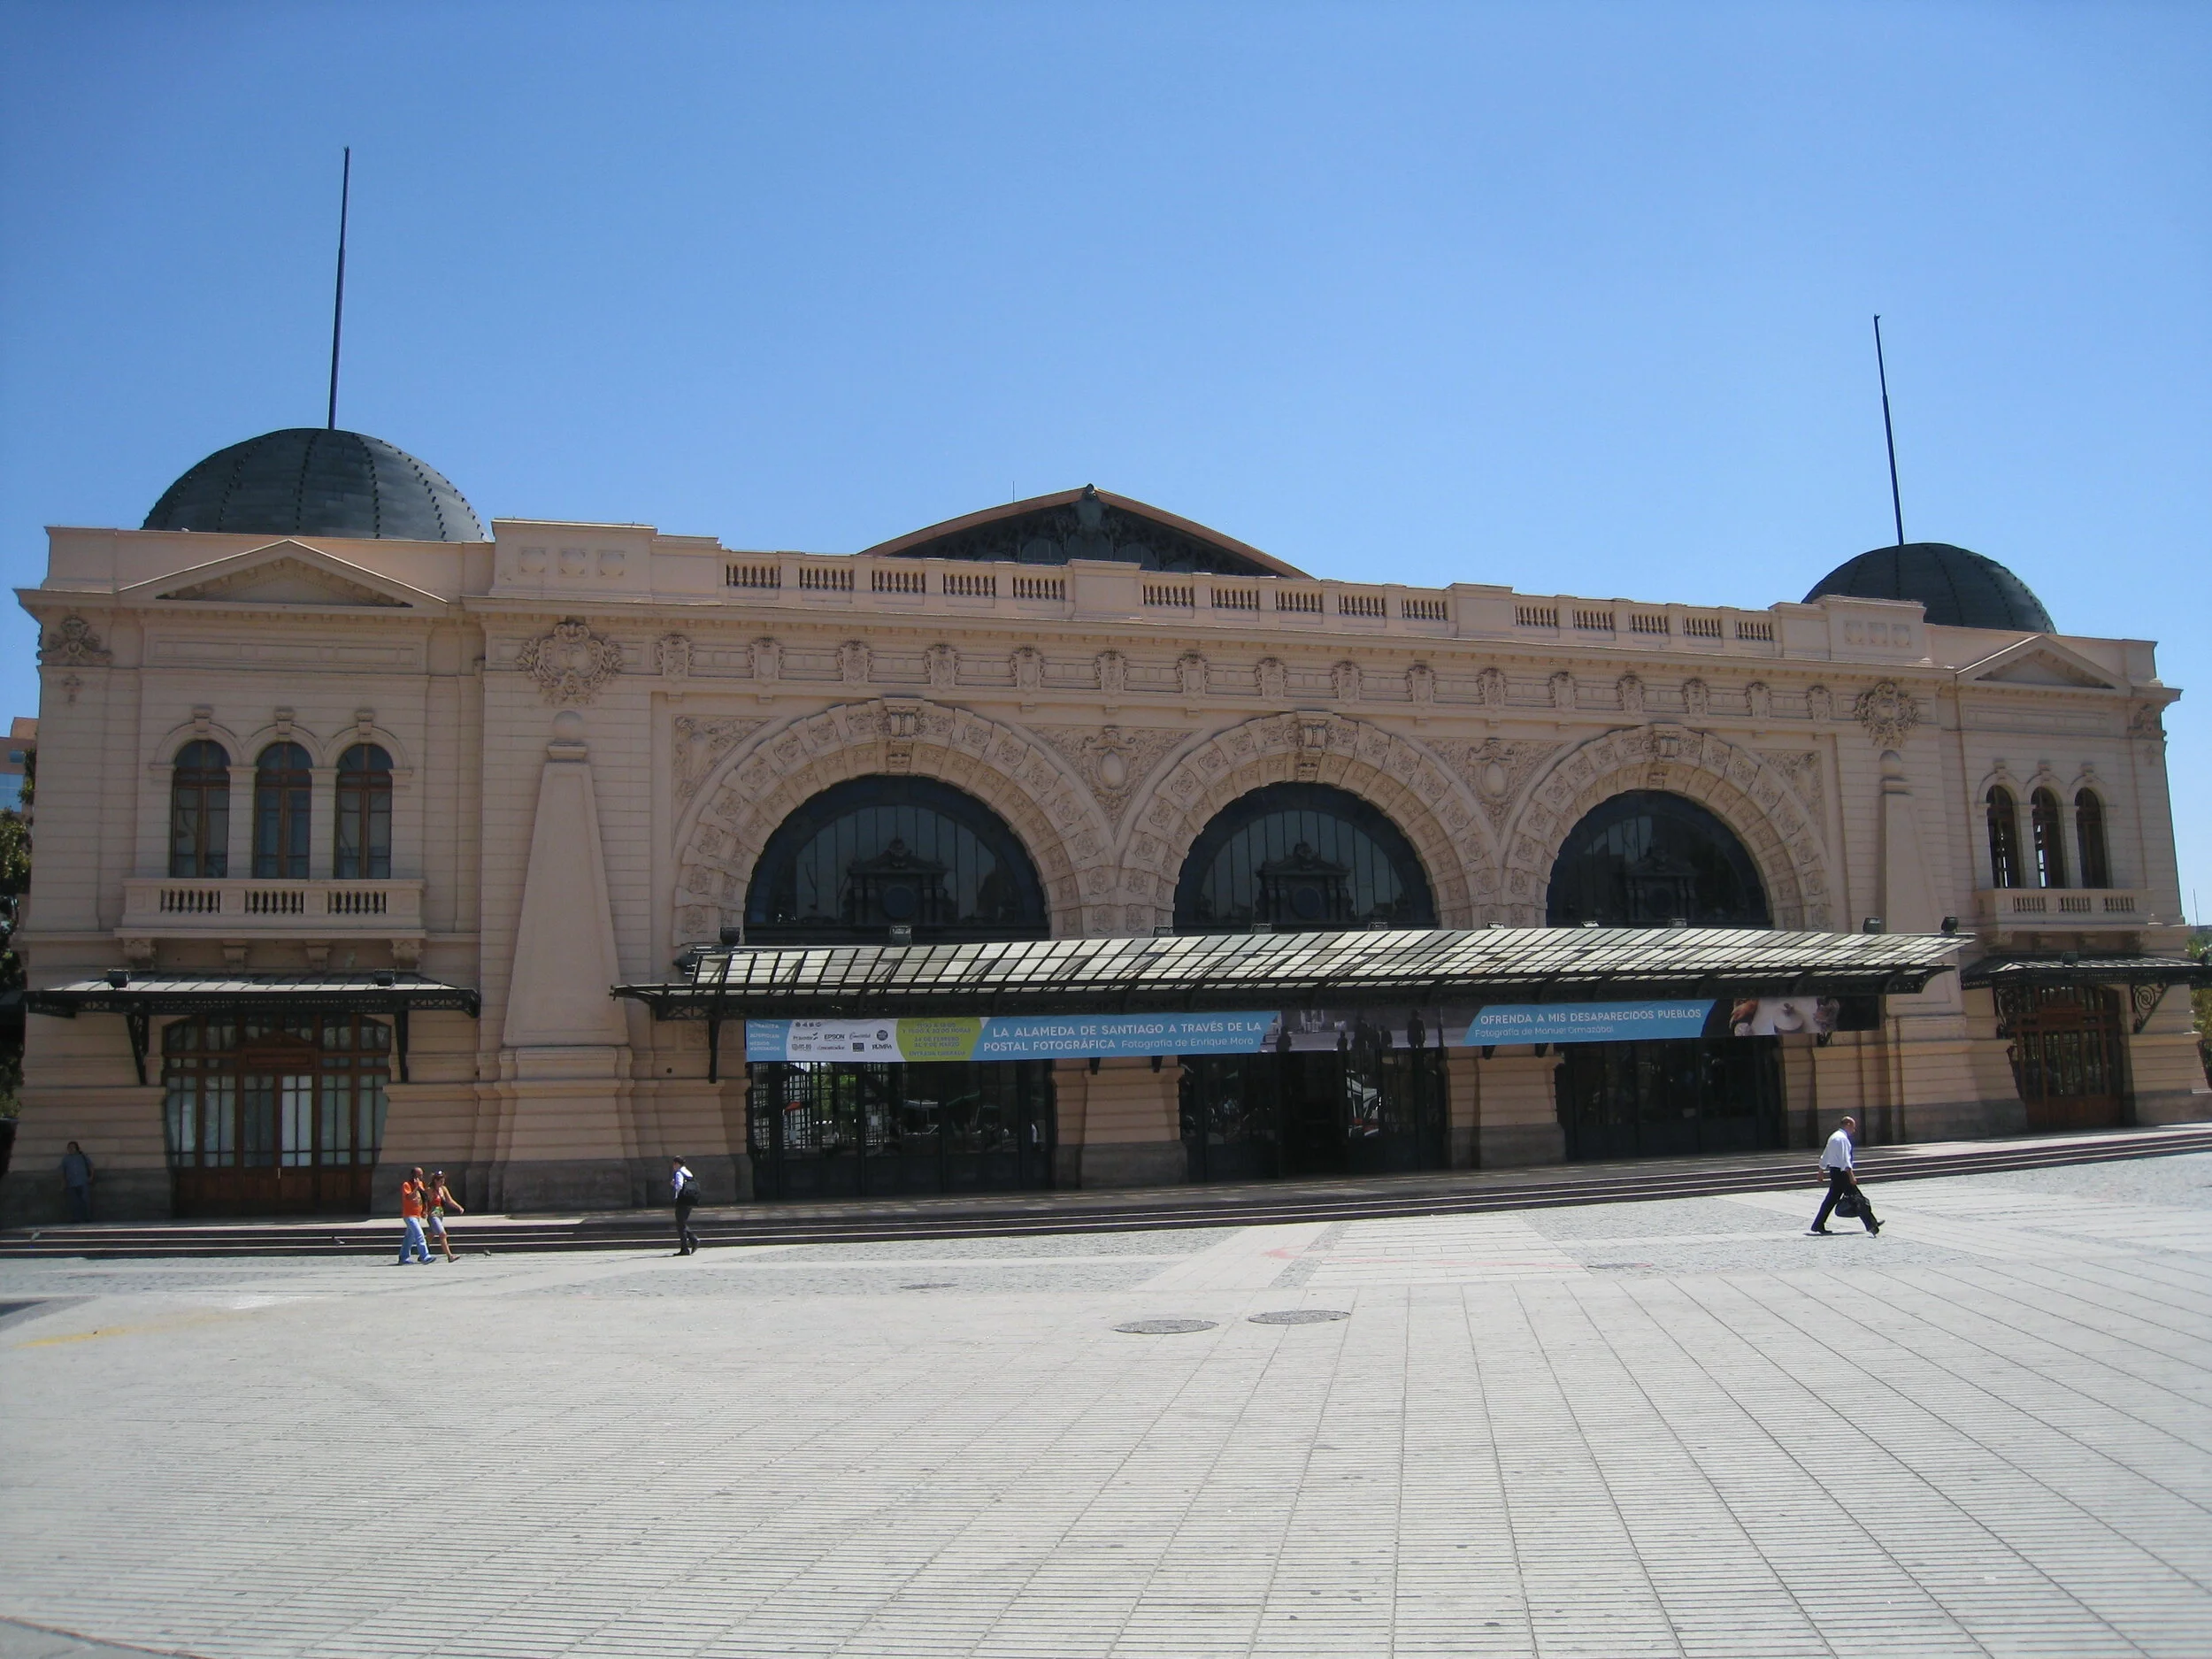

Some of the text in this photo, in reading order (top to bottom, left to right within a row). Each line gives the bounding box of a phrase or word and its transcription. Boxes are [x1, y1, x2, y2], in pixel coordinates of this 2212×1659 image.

[1480, 1009, 1701, 1025] OFRENDA A MIS DESAPARECIDOS PUEBLOS
[993, 1021, 1261, 1038] LA ALAMEDA DE SANTIAGO A TRAVÉS DE LA
[1521, 1026, 1532, 1035] de
[1535, 1026, 1566, 1035] Manuel
[983, 1041, 1028, 1052] POSTAL
[1033, 1038, 1116, 1050] FOTOGRÁFICA
[1190, 1037, 1228, 1048] Enrique
